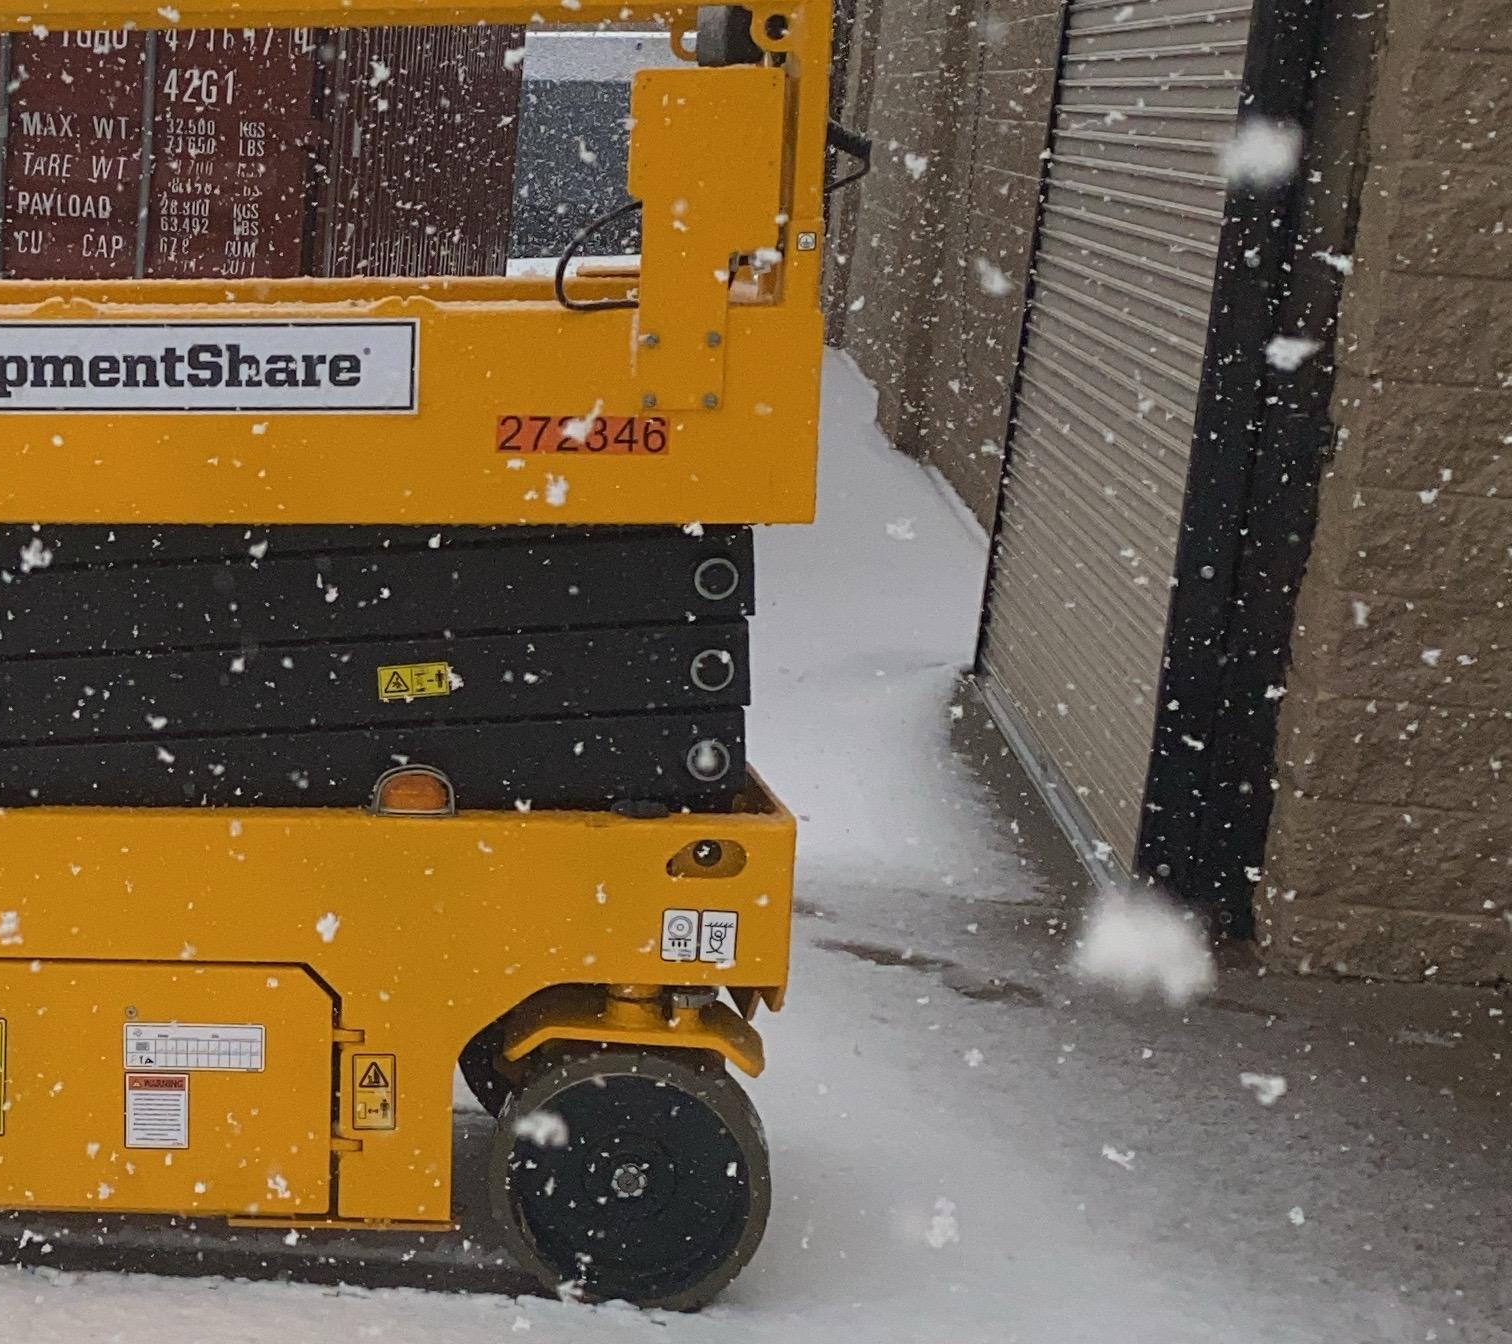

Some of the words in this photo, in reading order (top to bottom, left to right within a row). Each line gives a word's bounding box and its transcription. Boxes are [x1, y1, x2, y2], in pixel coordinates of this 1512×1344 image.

[163, 68, 235, 106] 42G1
[21, 112, 74, 137] MAX
[92, 115, 130, 140] WT
[239, 139, 265, 157] LBS
[22, 152, 73, 178] TARE
[92, 155, 128, 180] WT
[18, 191, 111, 219] PAYLOAD
[82, 233, 124, 259] CAP
[498, 415, 667, 453] 272346
